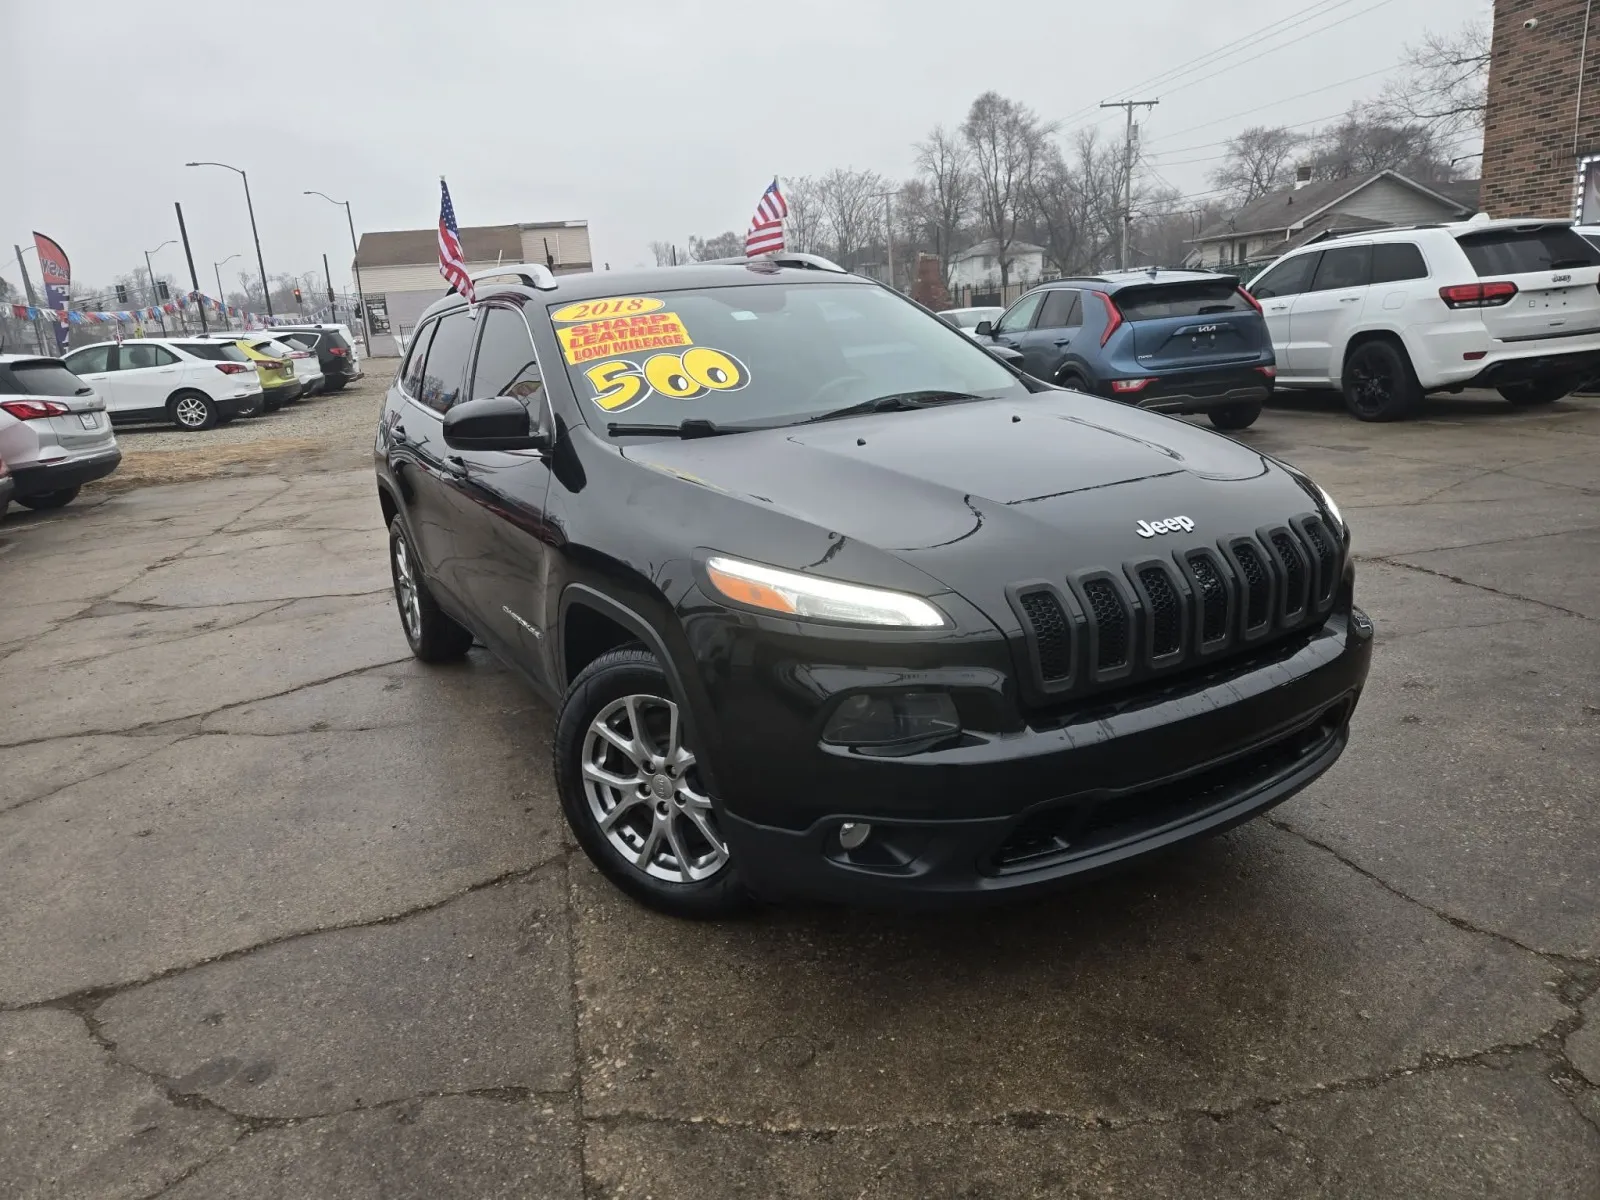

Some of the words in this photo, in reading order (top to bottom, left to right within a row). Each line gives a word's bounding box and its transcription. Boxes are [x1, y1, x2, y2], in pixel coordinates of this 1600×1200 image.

[573, 298, 644, 320] 2018
[569, 323, 680, 349] LEATHER
[570, 314, 670, 337] SHARP
[573, 344, 611, 361] LOW
[612, 334, 685, 354] MILEAGE
[1135, 515, 1195, 539] Jeep
